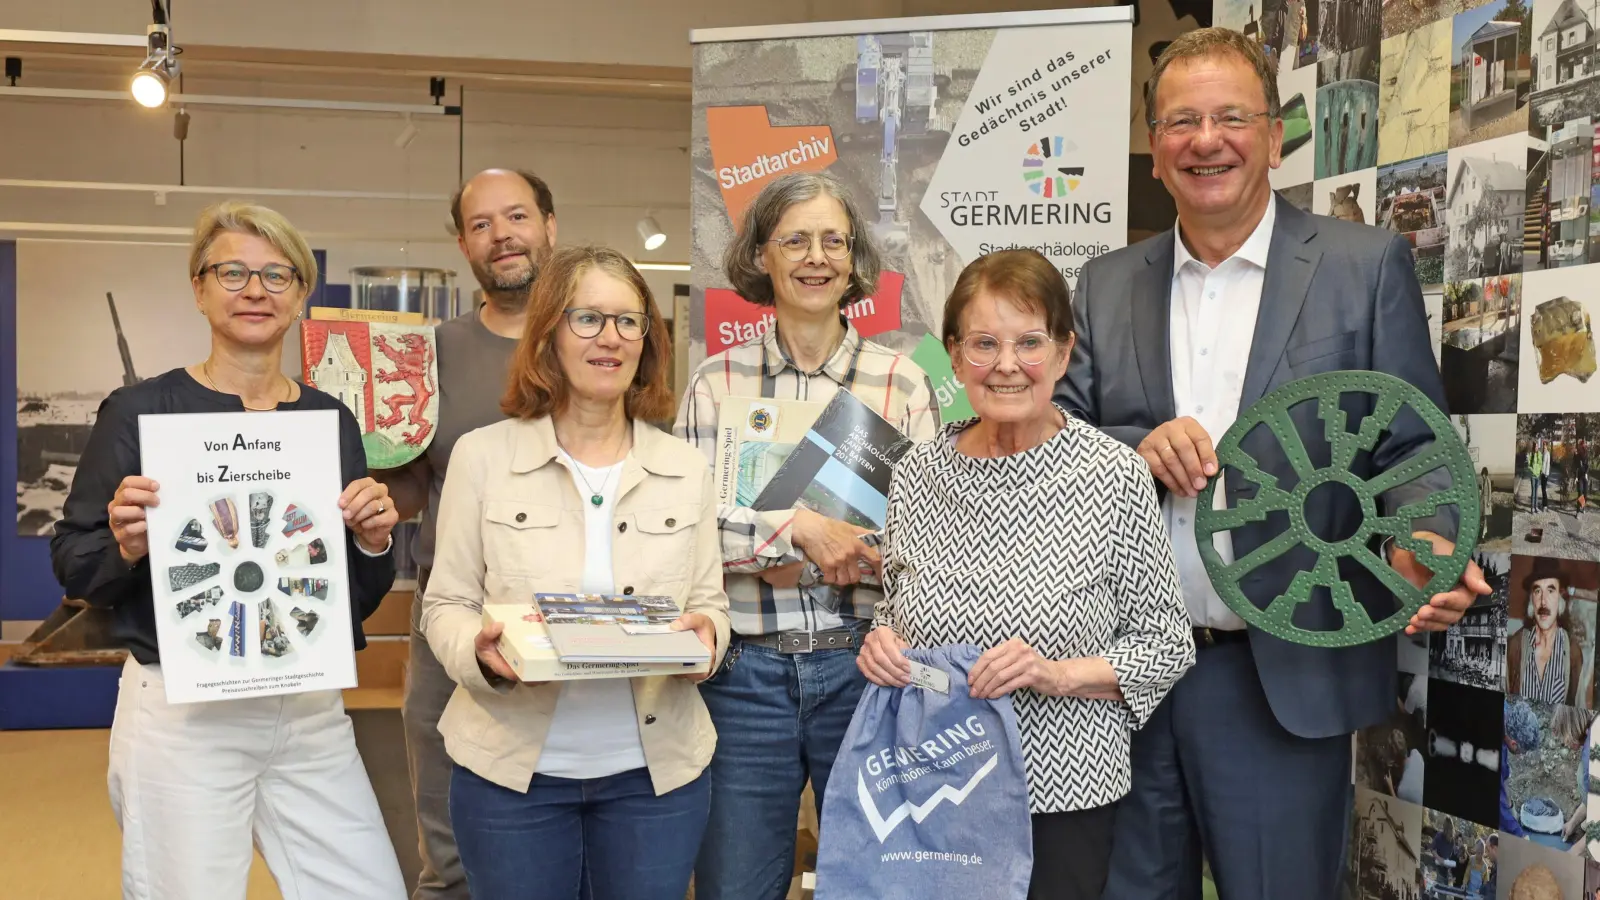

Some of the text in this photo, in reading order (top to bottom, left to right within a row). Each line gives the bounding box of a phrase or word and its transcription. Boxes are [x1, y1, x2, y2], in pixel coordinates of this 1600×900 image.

[974, 51, 1075, 115] Wir sind das
[958, 49, 1112, 147] Gedächtnis unserer
[1019, 96, 1068, 132] Stadt!
[719, 136, 829, 189] Stadtarchiv
[940, 190, 999, 209] STADT
[950, 202, 1112, 227] GERMERING
[853, 424, 869, 438] DAS
[204, 433, 281, 452] Von Anfang
[843, 438, 863, 454] JAHR
[720, 427, 733, 499] Germering-Spiel
[835, 449, 853, 465] 2015
[839, 443, 876, 473] IN BAYERN
[197, 465, 291, 483] bis Zierscheibe
[566, 662, 580, 670] Das
[196, 679, 242, 688] Fragegeschichten
[251, 676, 284, 684] Germeringer
[284, 672, 325, 681] Stadtgeschichte
[221, 685, 268, 693] Preisausschreiben
[932, 752, 965, 770] Kaum
[964, 738, 995, 758] besser.
[881, 849, 983, 866] www.germering.de
